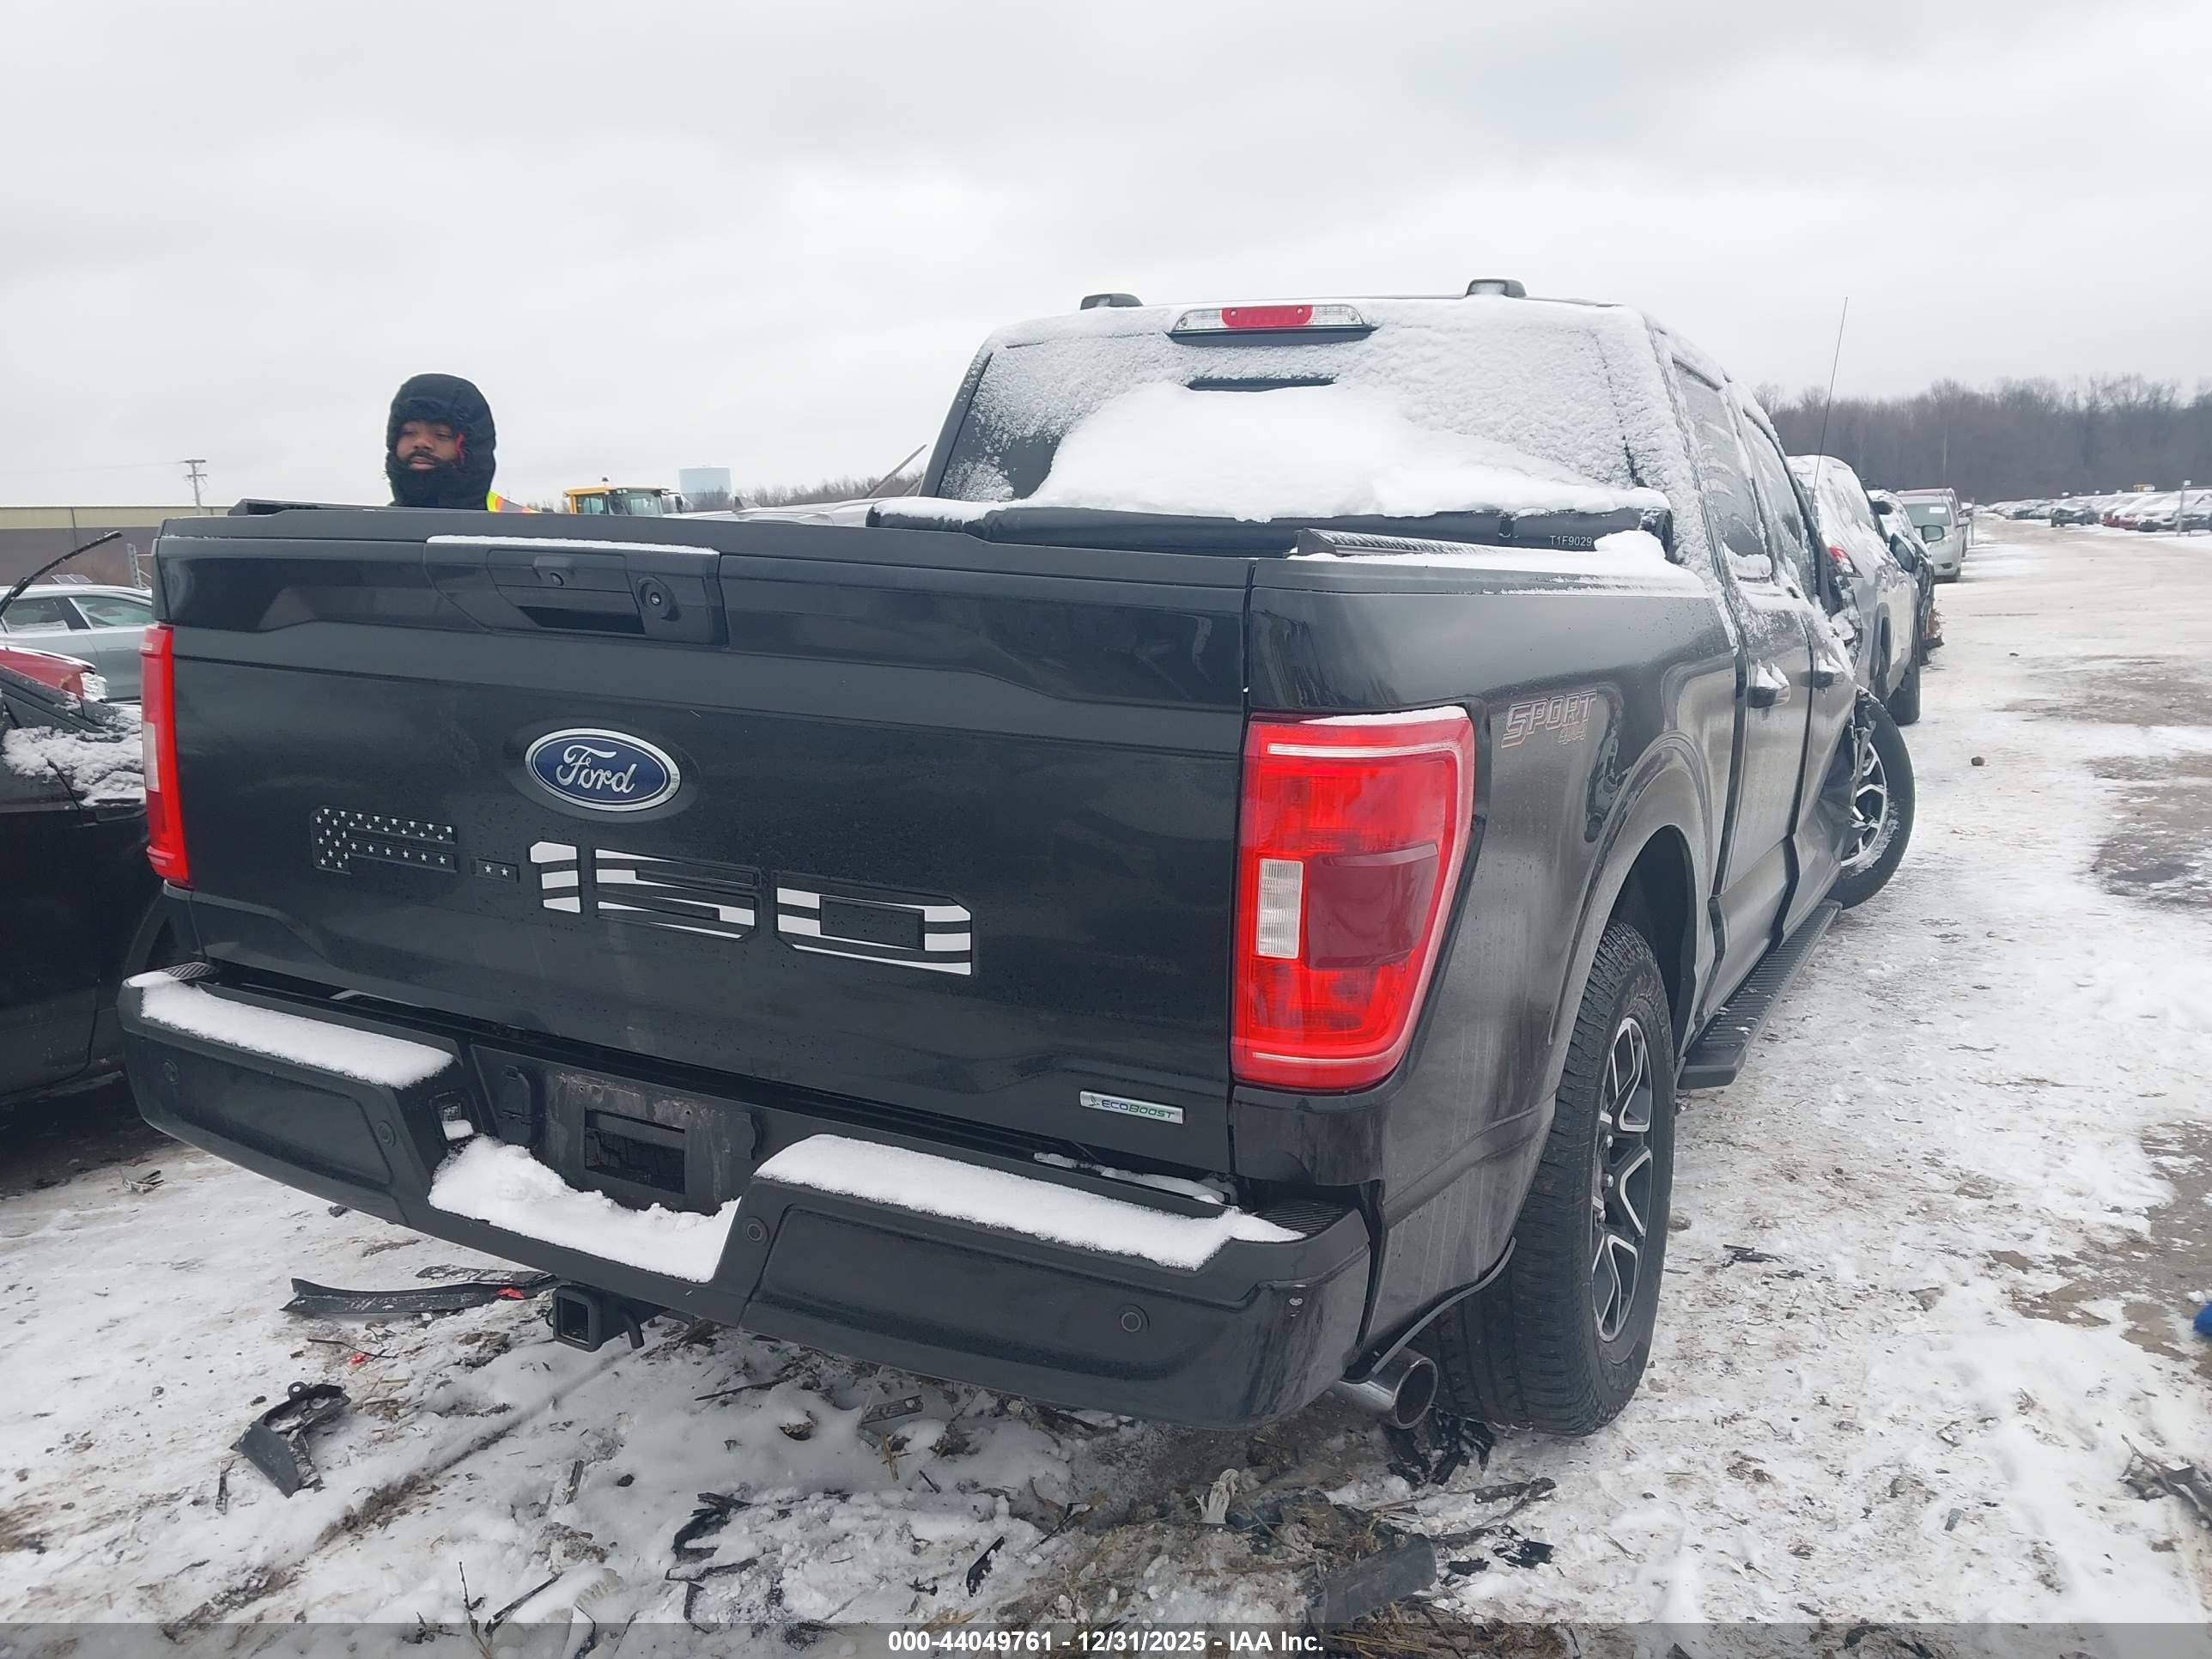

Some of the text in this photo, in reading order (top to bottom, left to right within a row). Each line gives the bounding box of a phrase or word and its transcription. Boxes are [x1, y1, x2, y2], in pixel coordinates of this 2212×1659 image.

[1549, 535, 1592, 547] T1F9029
[1501, 690, 1597, 749] SPORT
[556, 744, 637, 794] Ford
[310, 806, 974, 975] F-150
[1102, 1099, 1175, 1119] ECOBOOST
